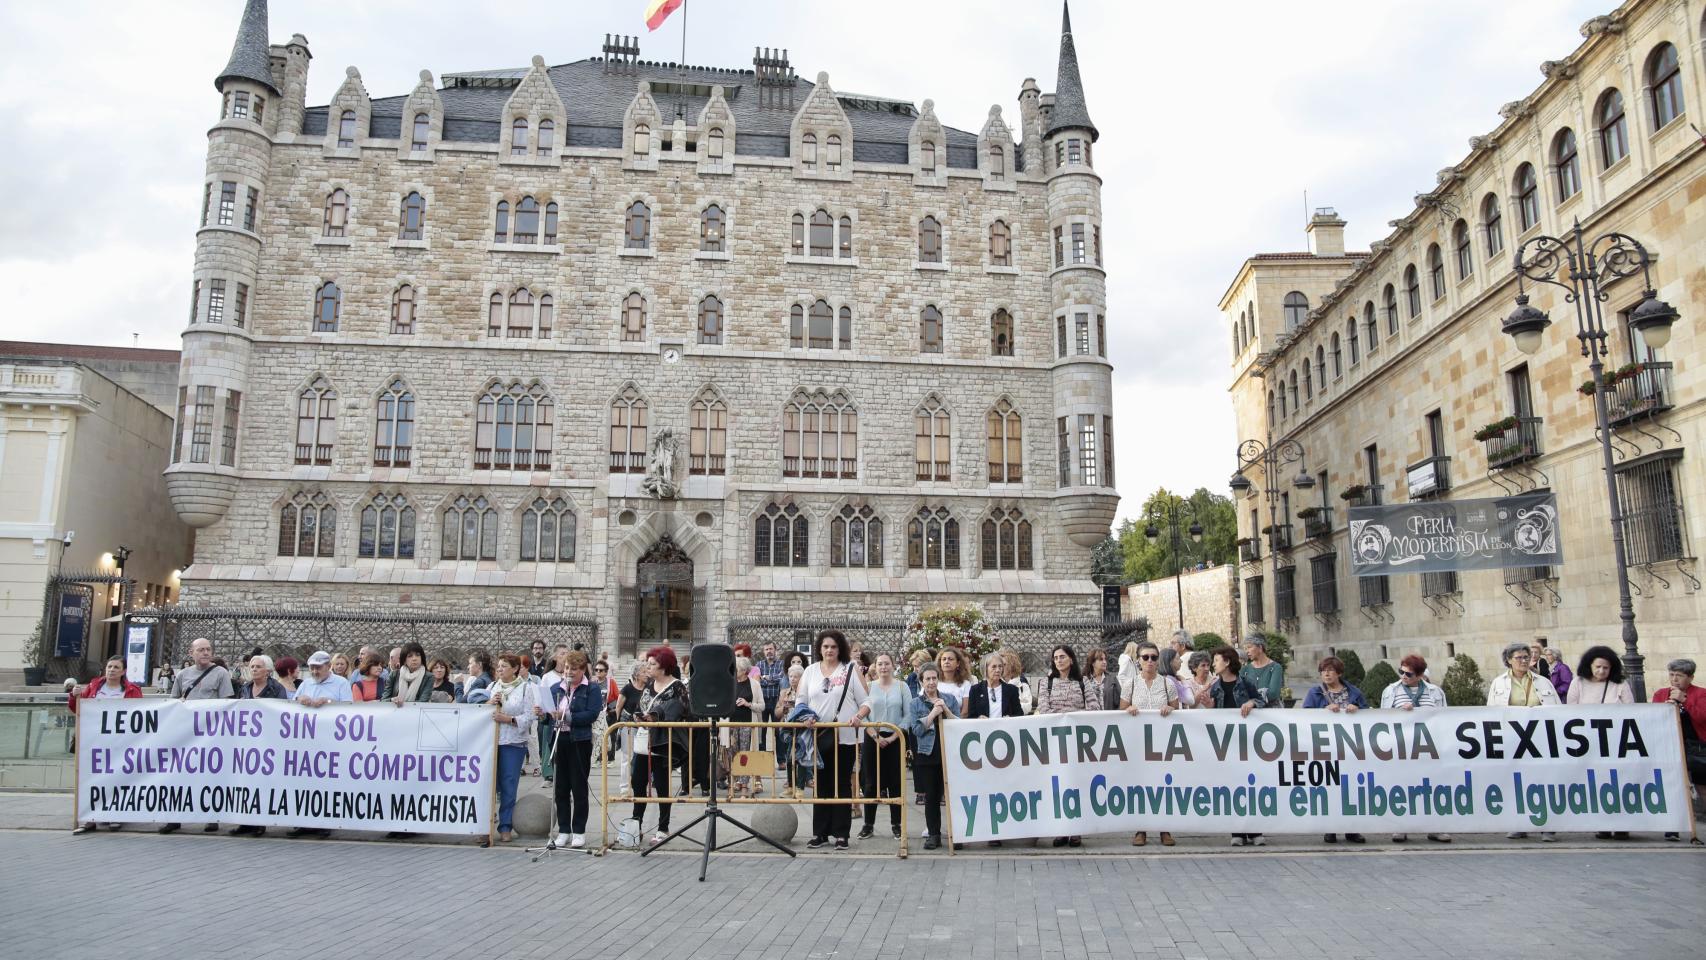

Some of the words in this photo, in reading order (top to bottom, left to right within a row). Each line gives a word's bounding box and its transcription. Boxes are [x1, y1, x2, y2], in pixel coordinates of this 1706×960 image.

[1407, 514, 1454, 535] FERIA
[1391, 529, 1490, 560] MODERNISTA
[100, 709, 159, 735] LEON
[193, 710, 263, 739] LUNES
[279, 711, 317, 740] SIN
[333, 716, 377, 742] SOL
[959, 724, 1129, 771] CONTRA
[1143, 723, 1194, 762] LA
[1206, 722, 1440, 762] VIOLENCIA
[1455, 717, 1650, 760] SEXISTA
[91, 747, 114, 774] EL
[121, 746, 224, 775] SILENCIO
[232, 748, 276, 776] NOS
[283, 750, 340, 779] HACE
[348, 744, 481, 784] CÓMPLICES
[1278, 760, 1340, 786] LEON
[89, 784, 194, 813] PLATAFORMA
[199, 785, 262, 815] CONTRA
[267, 787, 289, 816] LA
[294, 788, 385, 820] VIOLENCIA
[390, 793, 478, 824] MACHISTA
[960, 794, 979, 837] y
[988, 790, 1042, 835] por
[1051, 774, 1082, 820] la
[1089, 773, 1278, 817] Convivencia
[1288, 785, 1328, 817] en
[1340, 771, 1474, 817] Libertad
[1484, 783, 1504, 816] e
[1512, 768, 1668, 828] Igualdad
